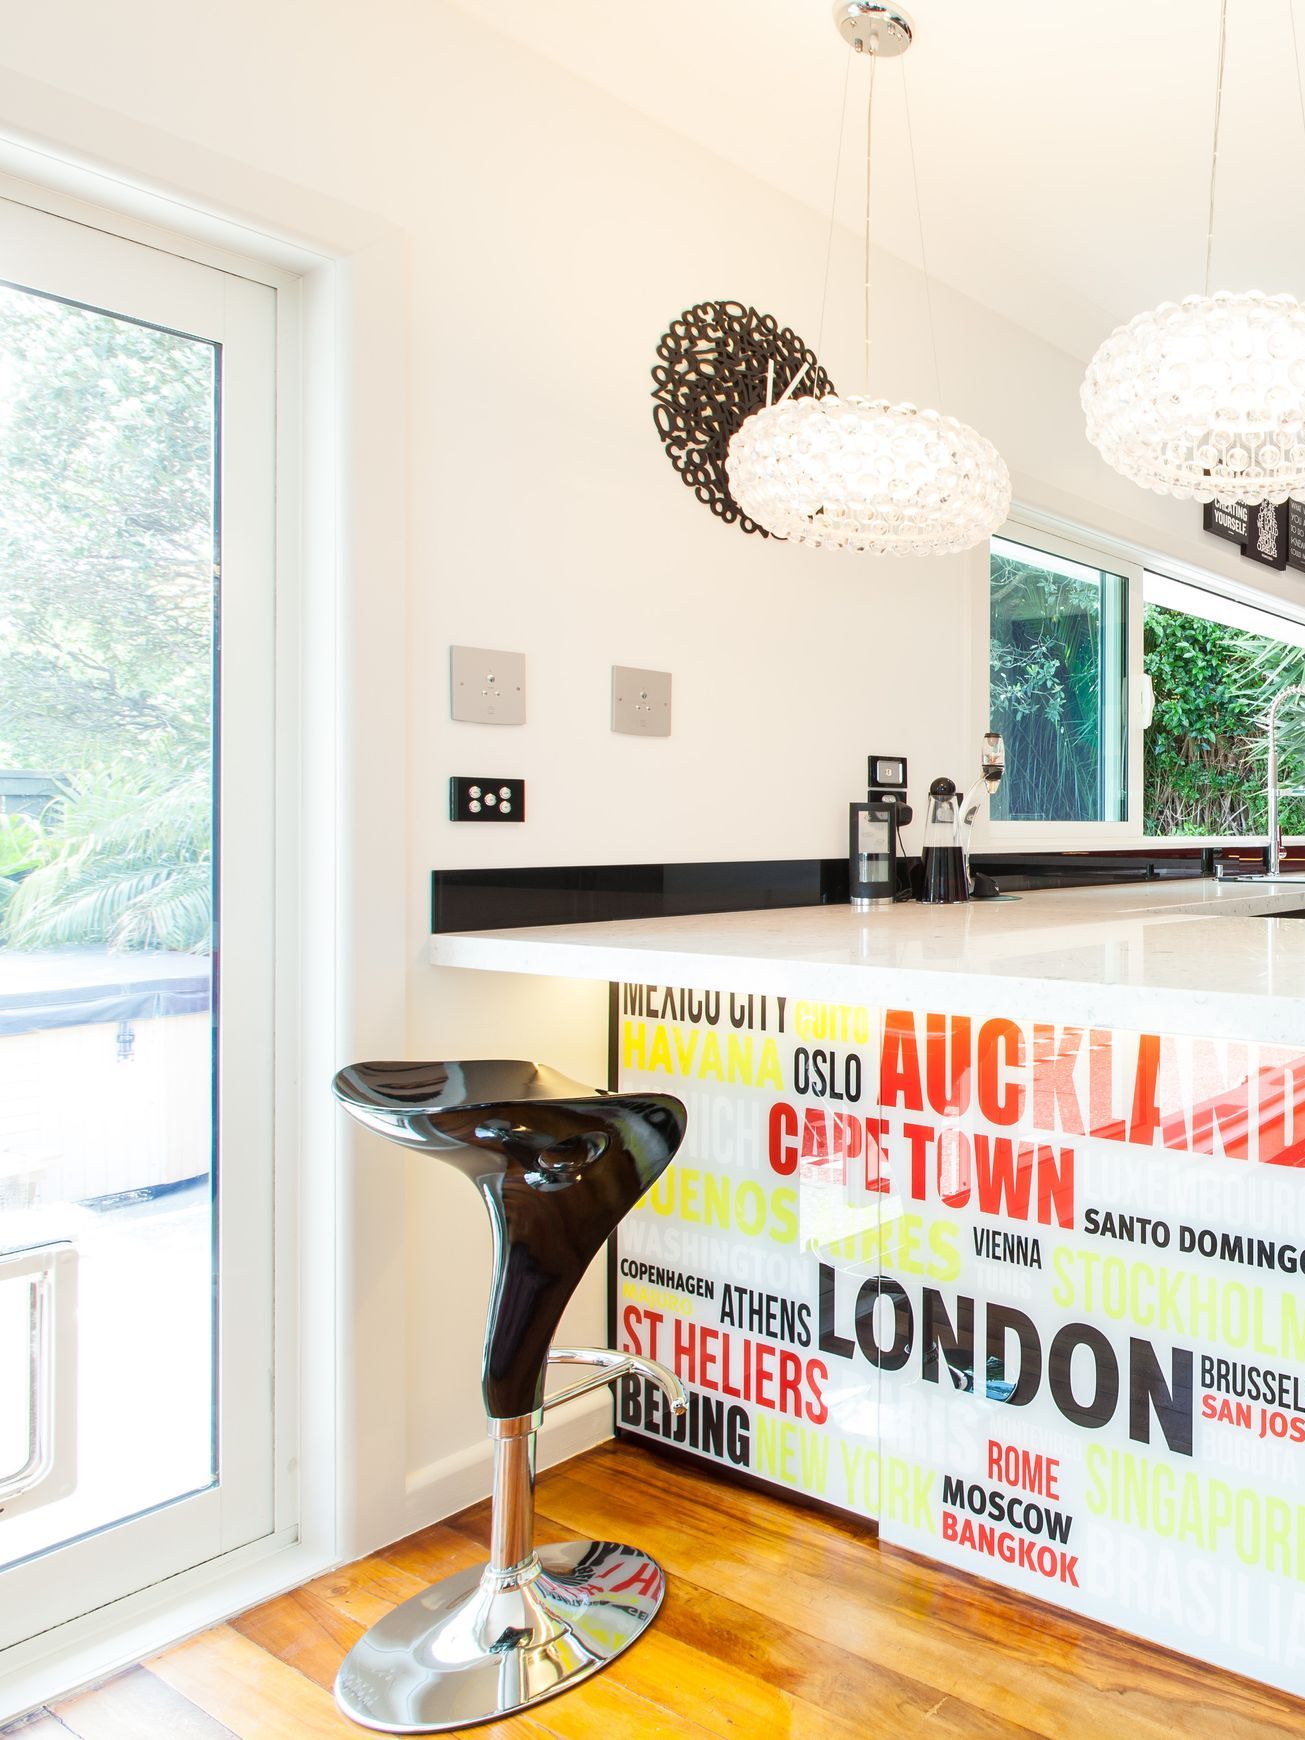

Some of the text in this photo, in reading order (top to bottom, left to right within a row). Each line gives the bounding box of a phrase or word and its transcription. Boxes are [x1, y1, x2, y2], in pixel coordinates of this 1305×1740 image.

[1214, 509, 1248, 536] YOURSELF.
[624, 983, 786, 1033] MEXICO CITY
[795, 1001, 869, 1045] QUITO
[623, 1020, 784, 1091] HAVANA
[794, 1047, 861, 1102] OSLO
[768, 1101, 890, 1194] CAPE
[903, 1122, 1075, 1230] TOWN
[632, 1163, 798, 1244] UENOS
[1084, 1207, 1170, 1249] SANTO
[620, 1258, 714, 1299] COPENHAGEN
[623, 1220, 810, 1297] WASHINGTON
[973, 1226, 1042, 1270] VIENNA
[623, 1282, 693, 1316] MAJURO
[720, 1283, 811, 1348] ATHENS
[623, 1305, 828, 1425] ST HELIERS
[819, 1262, 1193, 1457] LONDON
[621, 1373, 750, 1467] BEIJING
[1201, 1393, 1251, 1429] SAN
[757, 1417, 937, 1536] NEW YORK
[987, 1439, 1060, 1501] ROME
[943, 1475, 1072, 1545] MOSCOW
[943, 1511, 1080, 1588] BANGKOK
